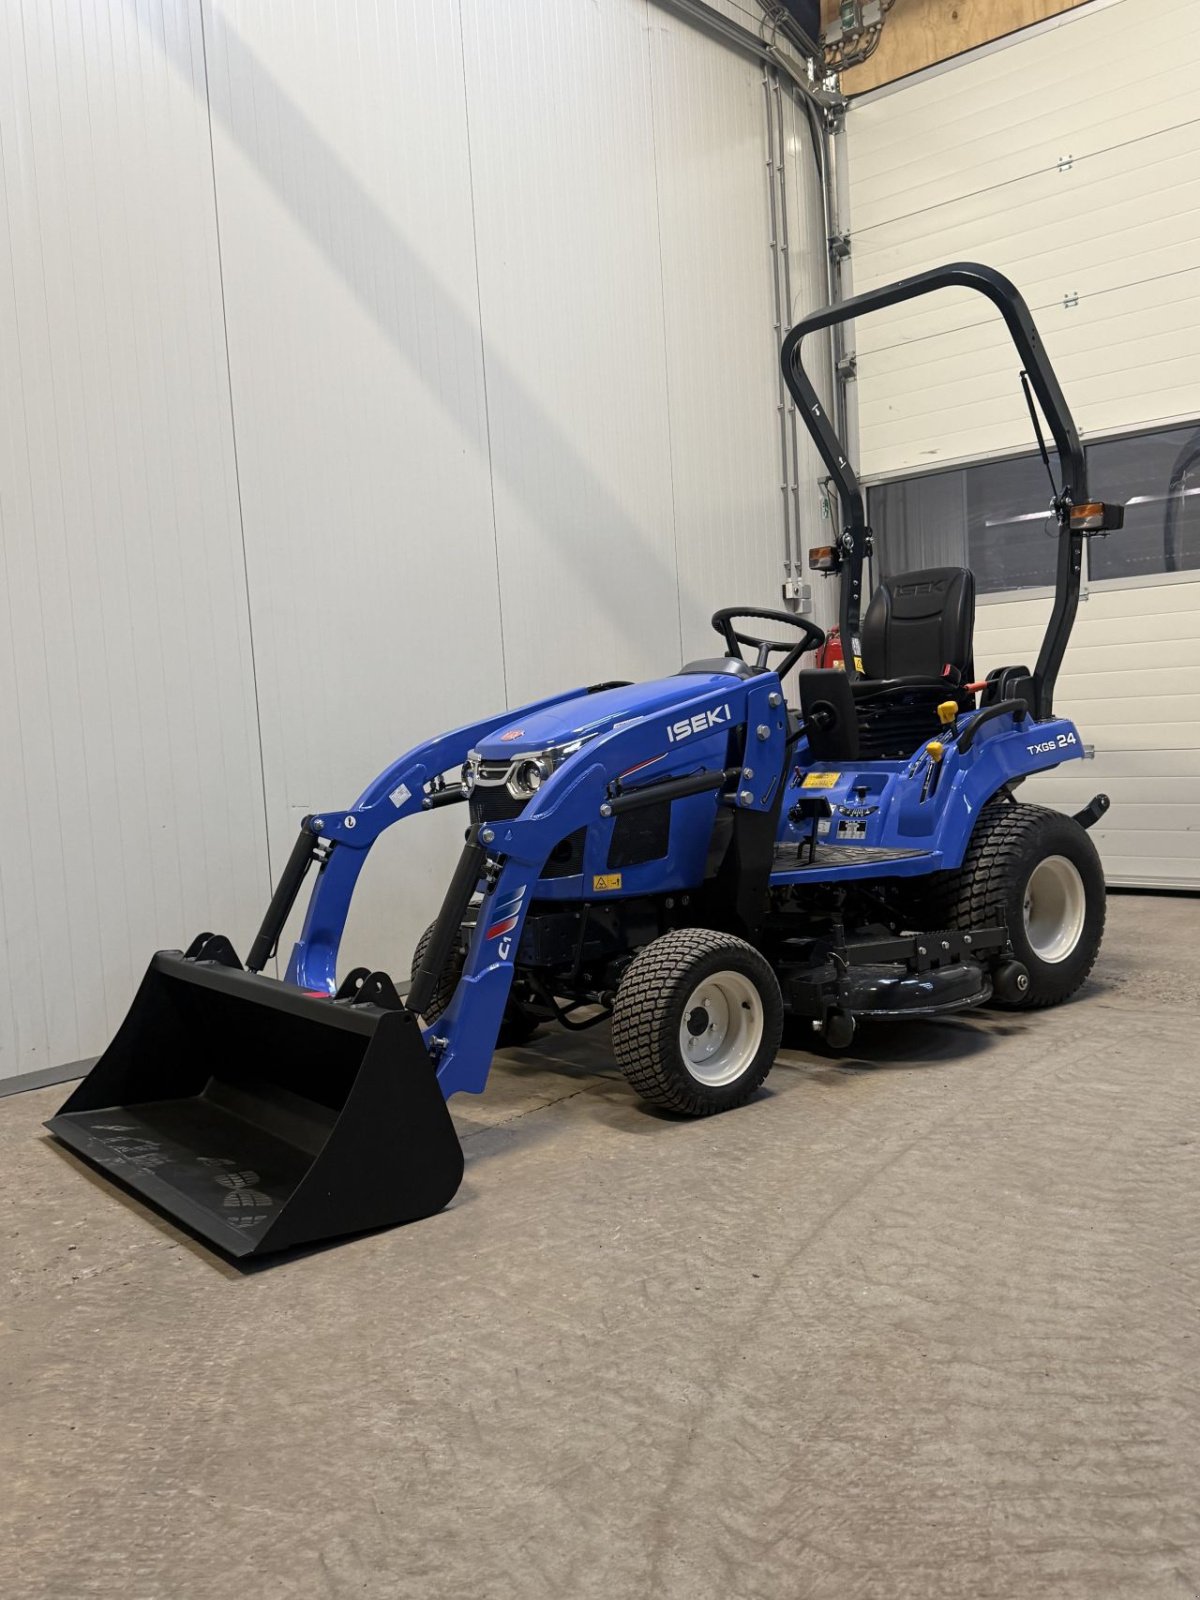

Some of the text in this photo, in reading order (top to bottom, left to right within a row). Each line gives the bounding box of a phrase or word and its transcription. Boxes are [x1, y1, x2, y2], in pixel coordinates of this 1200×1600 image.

[666, 703, 732, 743] ISEKI
[1026, 732, 1077, 755] TXGS 24
